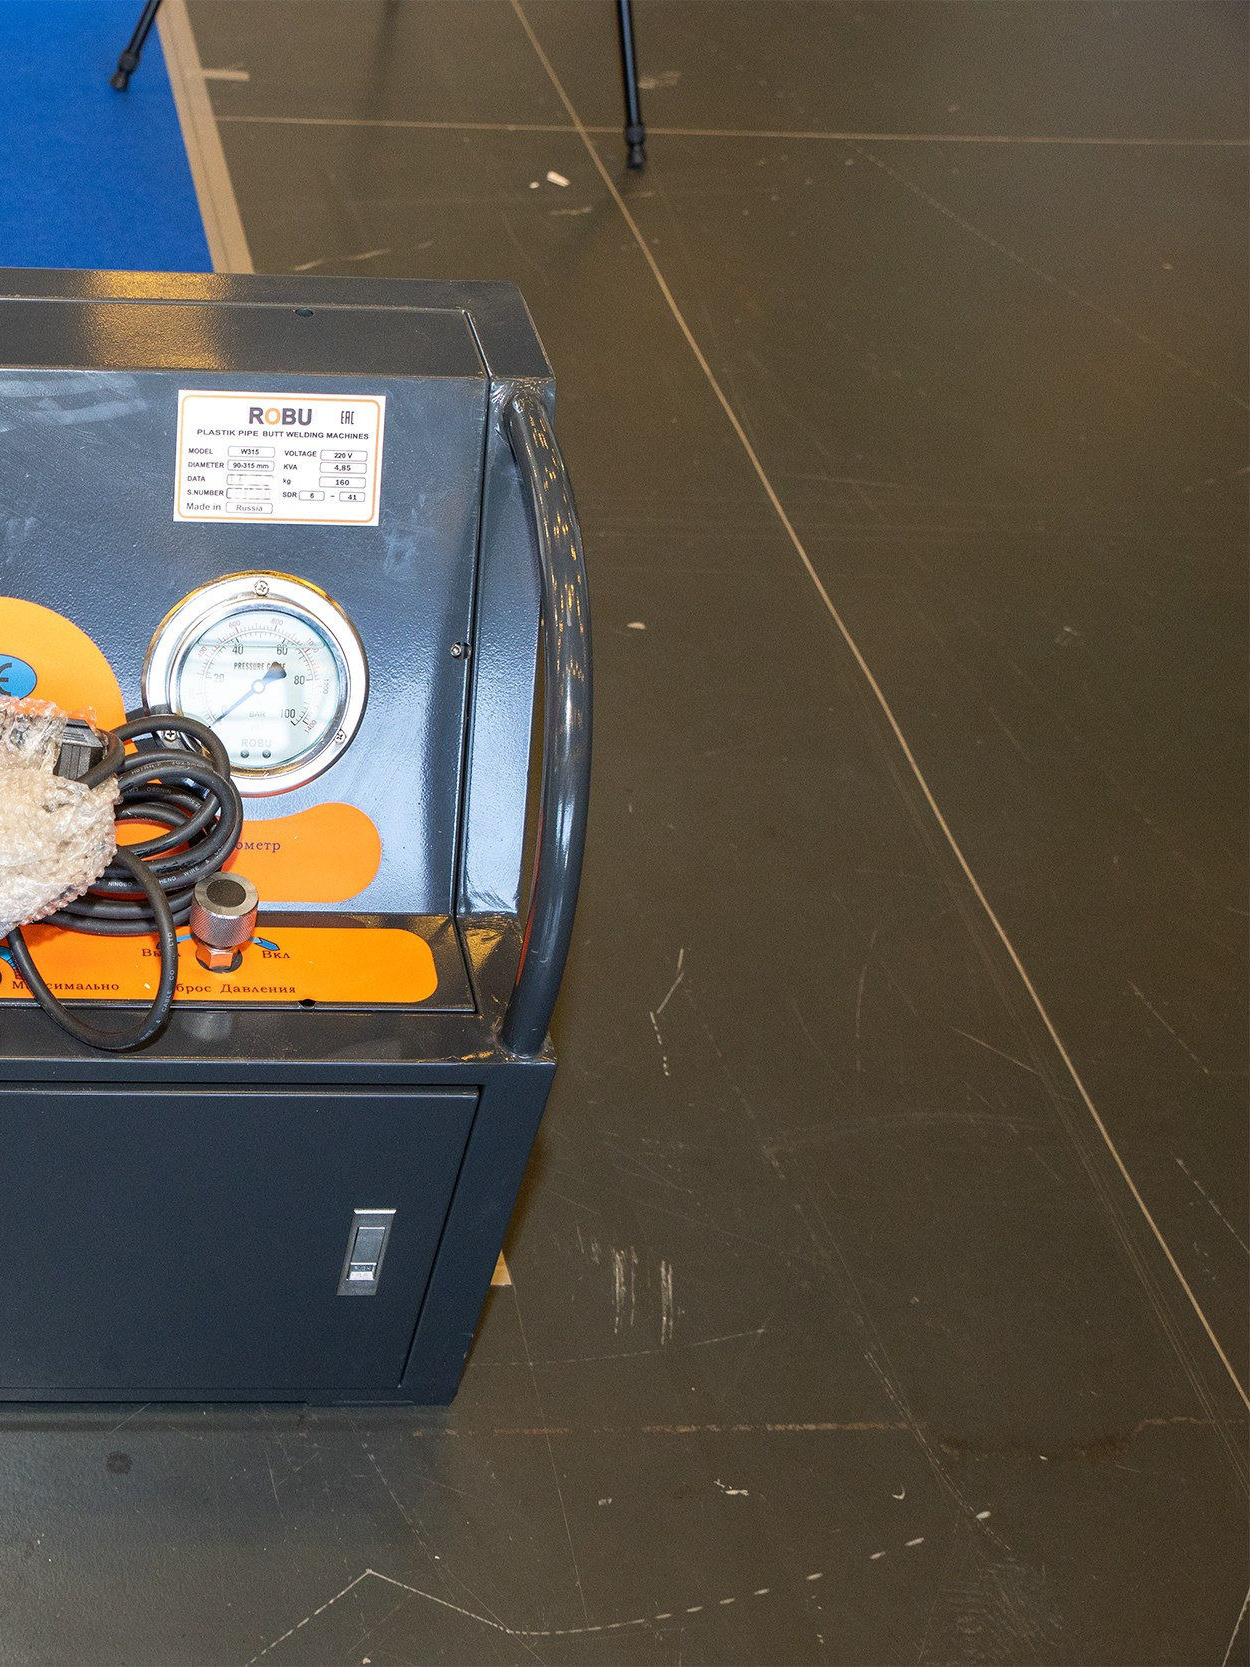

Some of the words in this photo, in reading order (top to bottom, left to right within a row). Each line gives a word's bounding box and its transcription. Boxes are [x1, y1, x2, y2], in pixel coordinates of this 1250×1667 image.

[249, 407, 312, 426] ROBU
[197, 428, 235, 436] PLASTIK
[326, 432, 369, 440] MACHINES
[284, 450, 317, 458] VOLTAGE
[236, 504, 263, 512] Russia
[271, 618, 283, 626] 800
[232, 644, 244, 655] 40
[276, 644, 288, 655] 60
[234, 662, 264, 670] PRESSURE
[214, 673, 225, 683] 20
[294, 675, 306, 685] 80
[280, 709, 295, 718] 100
[241, 739, 272, 748] ROBU
[236, 841, 281, 853] ометр
[262, 950, 290, 958] Вкл
[176, 984, 212, 993] брос
[220, 984, 296, 993] Давления
